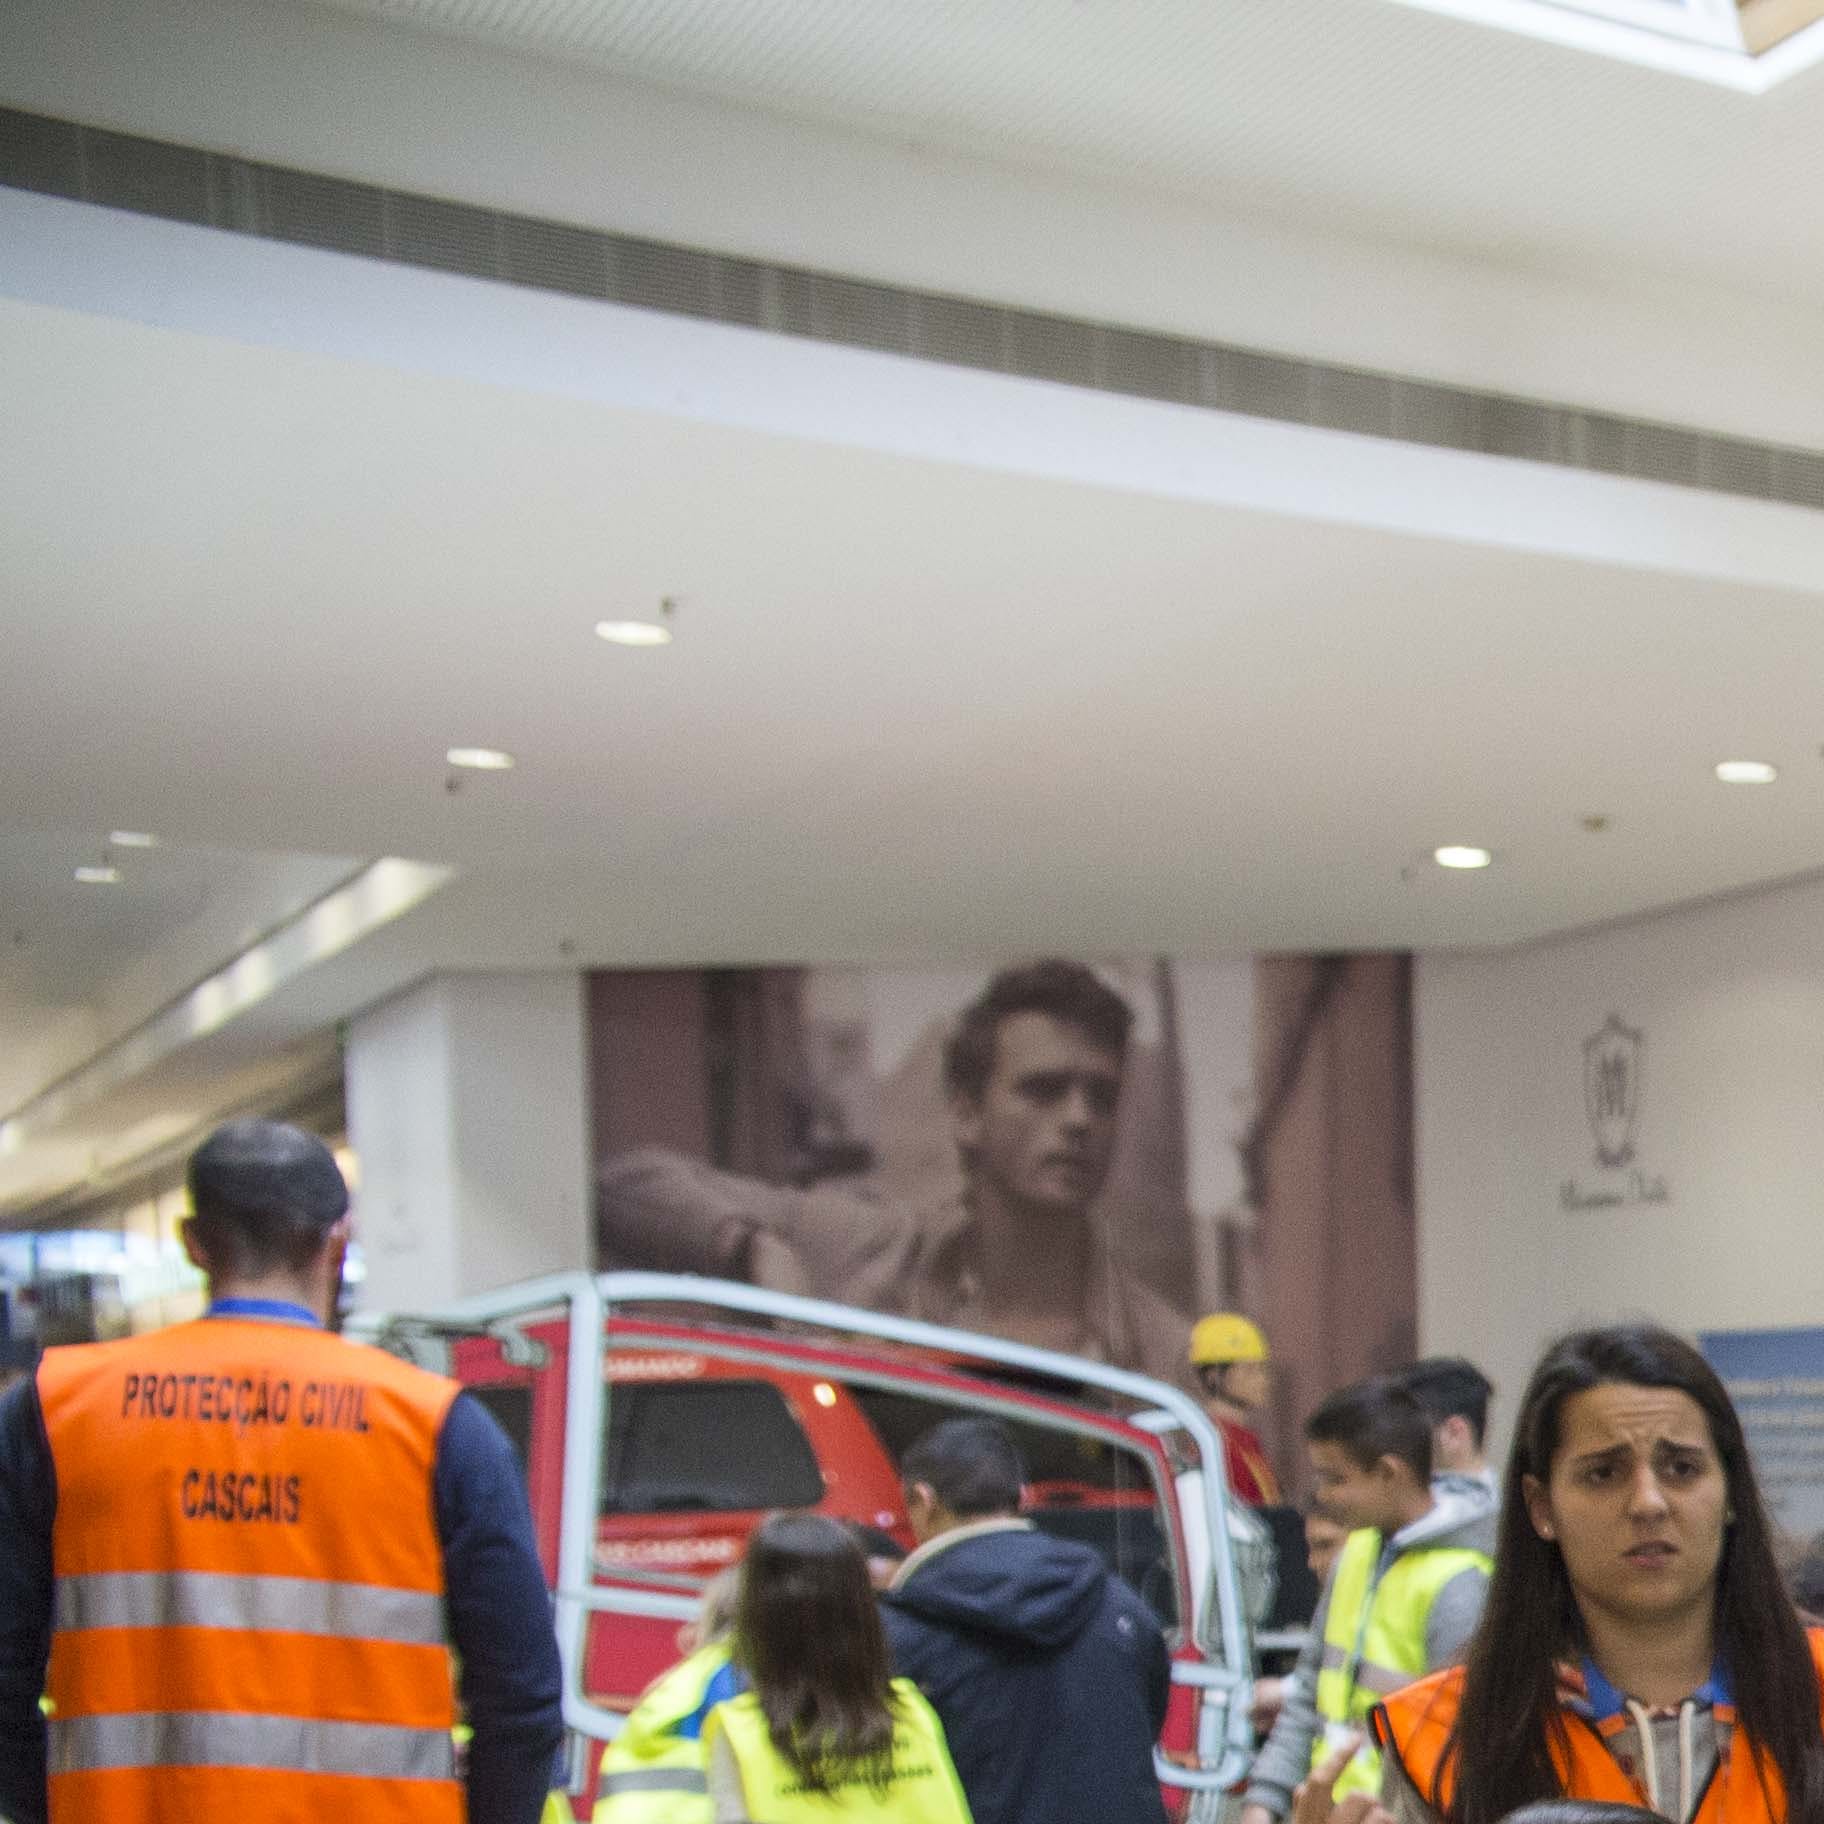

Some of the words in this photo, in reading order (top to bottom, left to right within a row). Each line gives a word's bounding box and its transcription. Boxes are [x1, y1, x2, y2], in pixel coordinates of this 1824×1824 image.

[120, 1372, 290, 1428] PROTECÇÃO
[301, 1382, 373, 1432] CIVIL
[179, 1467, 303, 1525] CASCAIS
